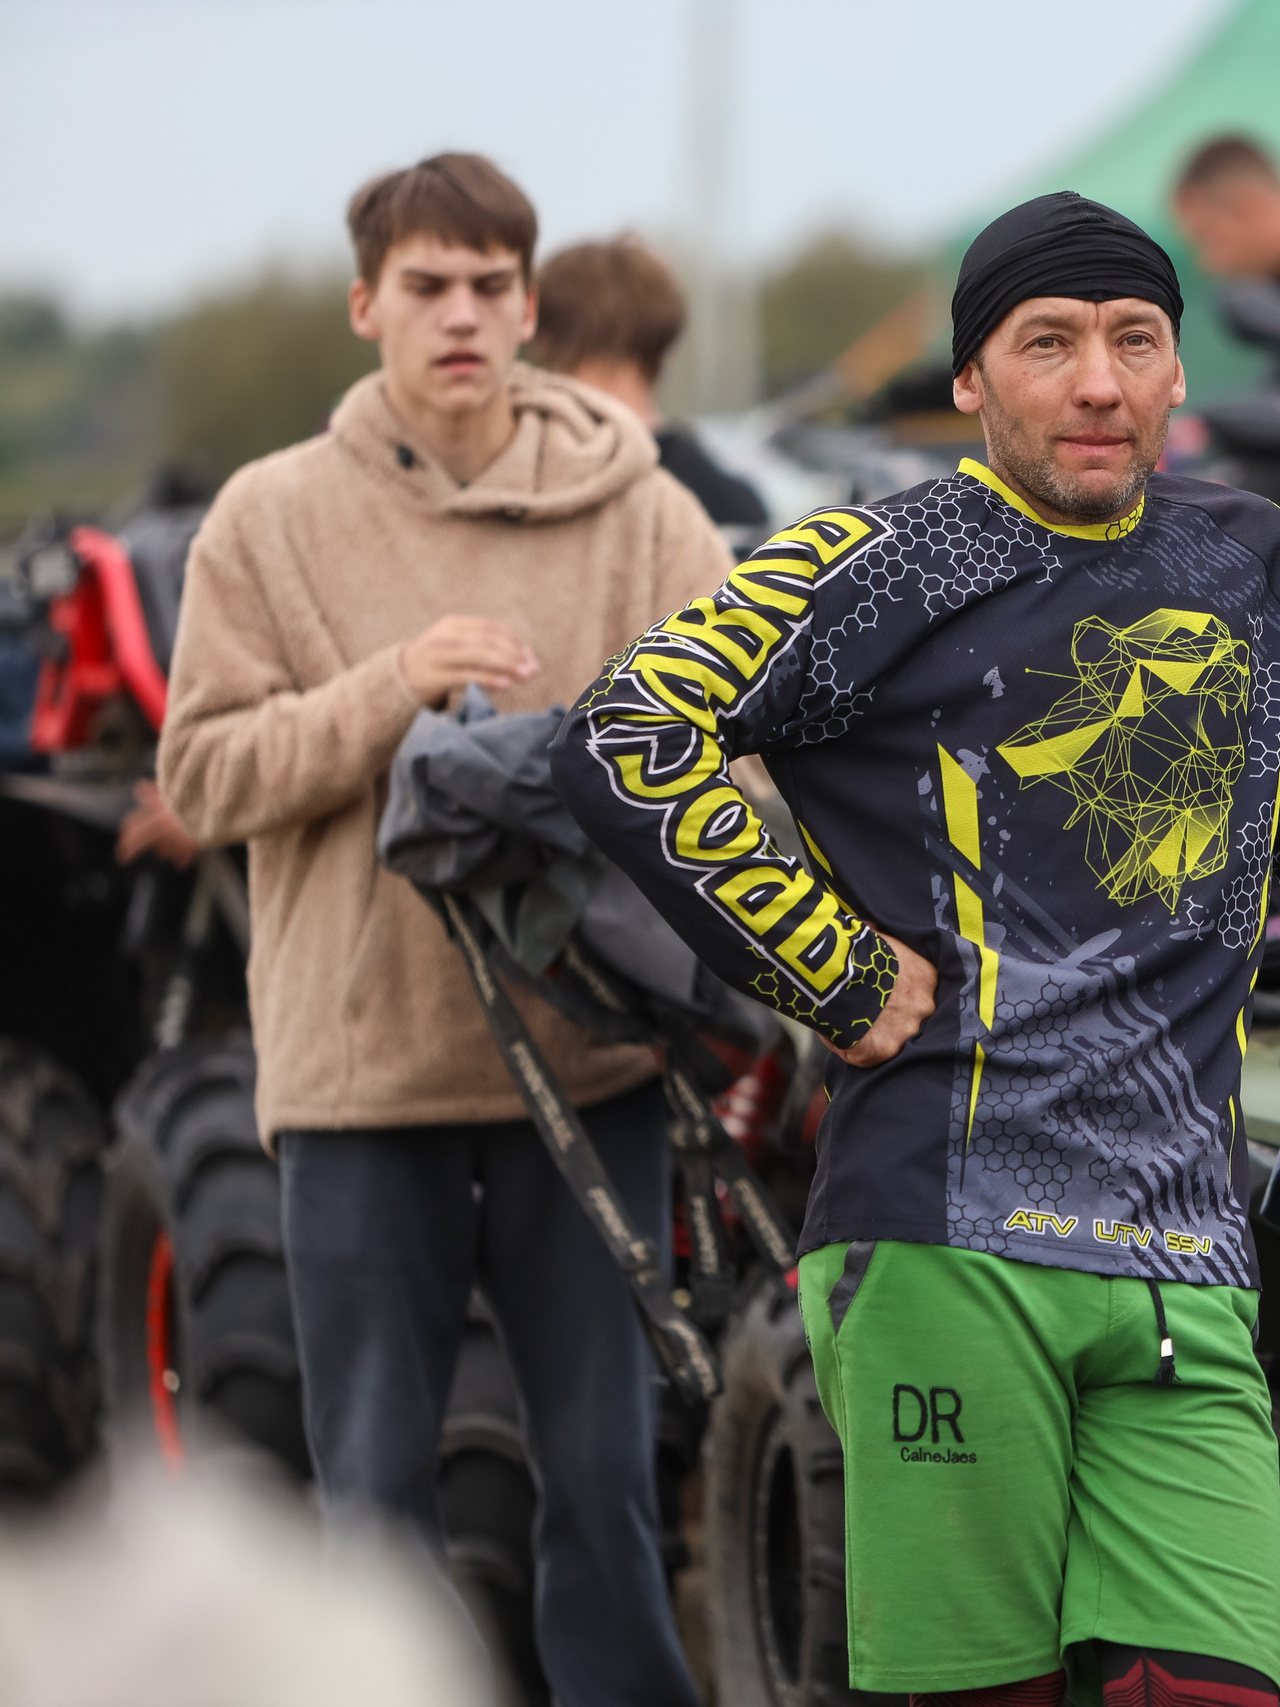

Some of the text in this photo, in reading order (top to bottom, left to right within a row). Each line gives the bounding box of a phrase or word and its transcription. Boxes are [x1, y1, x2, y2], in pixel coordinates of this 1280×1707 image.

[596, 508, 880, 1000] ЯРОСАВЛЬ
[1005, 1209, 1212, 1255] ATV UTV SSV
[892, 1383, 965, 1444] DR
